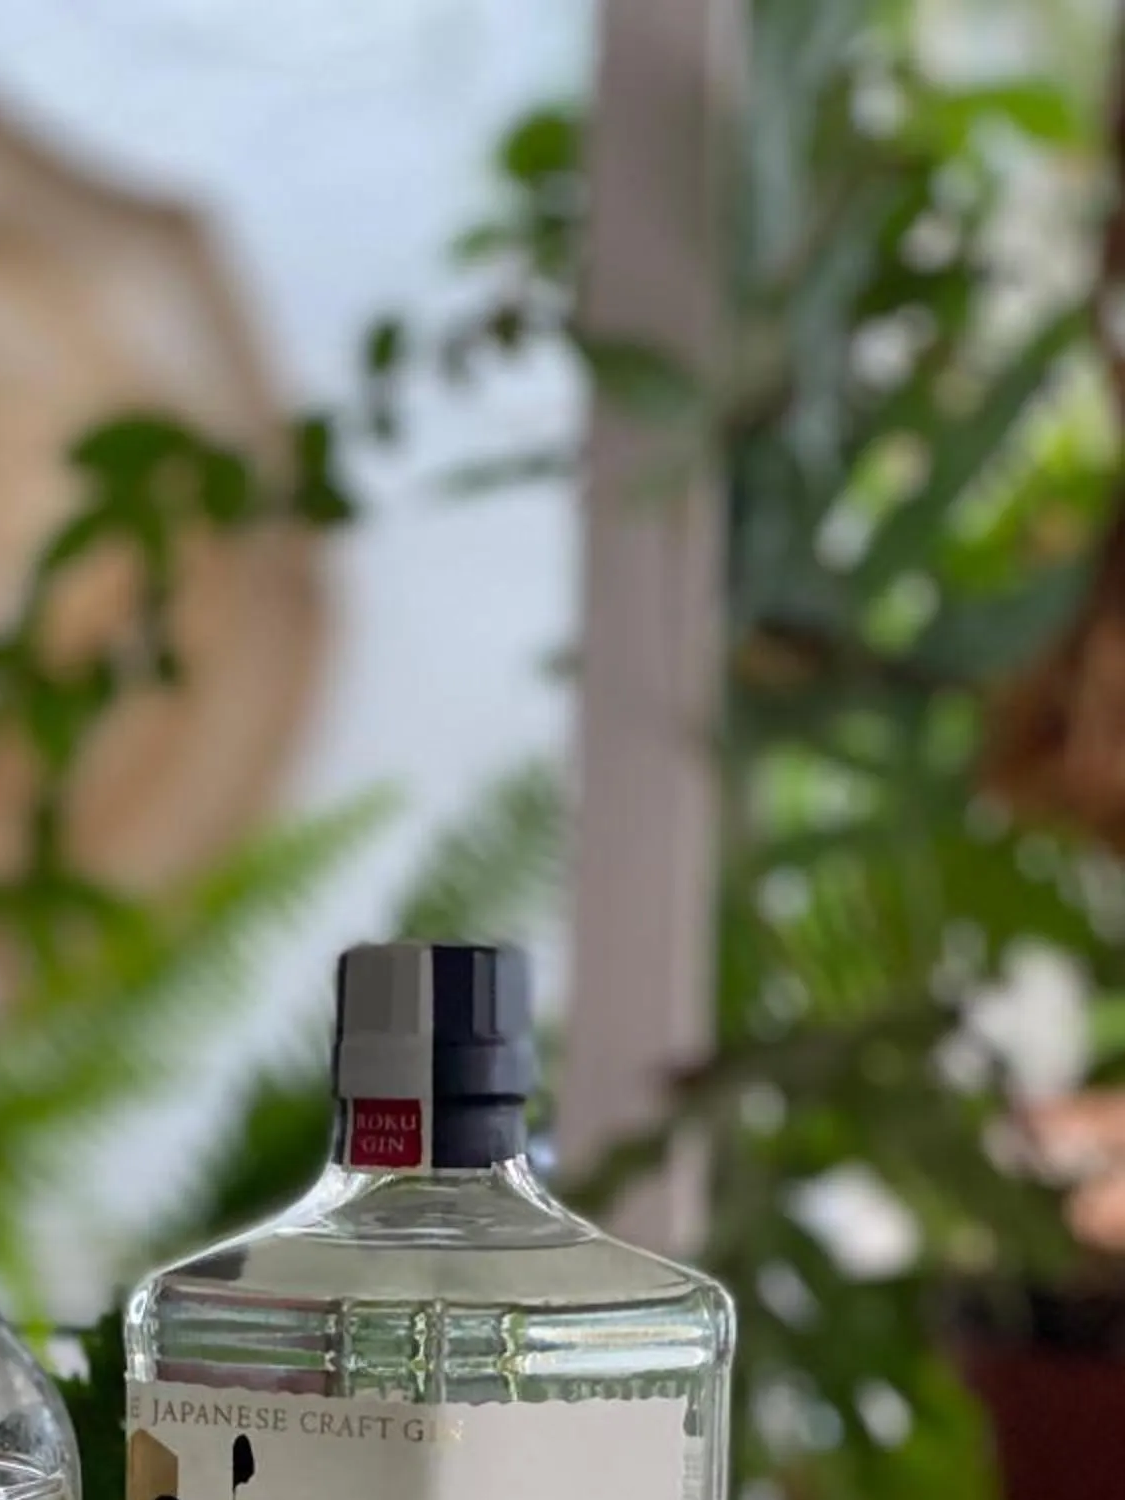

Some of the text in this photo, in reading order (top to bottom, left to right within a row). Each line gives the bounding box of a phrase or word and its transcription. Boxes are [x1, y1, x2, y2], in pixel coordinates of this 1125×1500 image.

[357, 1113, 417, 1132] ROKU
[361, 1136, 405, 1154] GIN
[152, 1398, 289, 1432] JAPANESE
[299, 1410, 395, 1440] CRAFT
